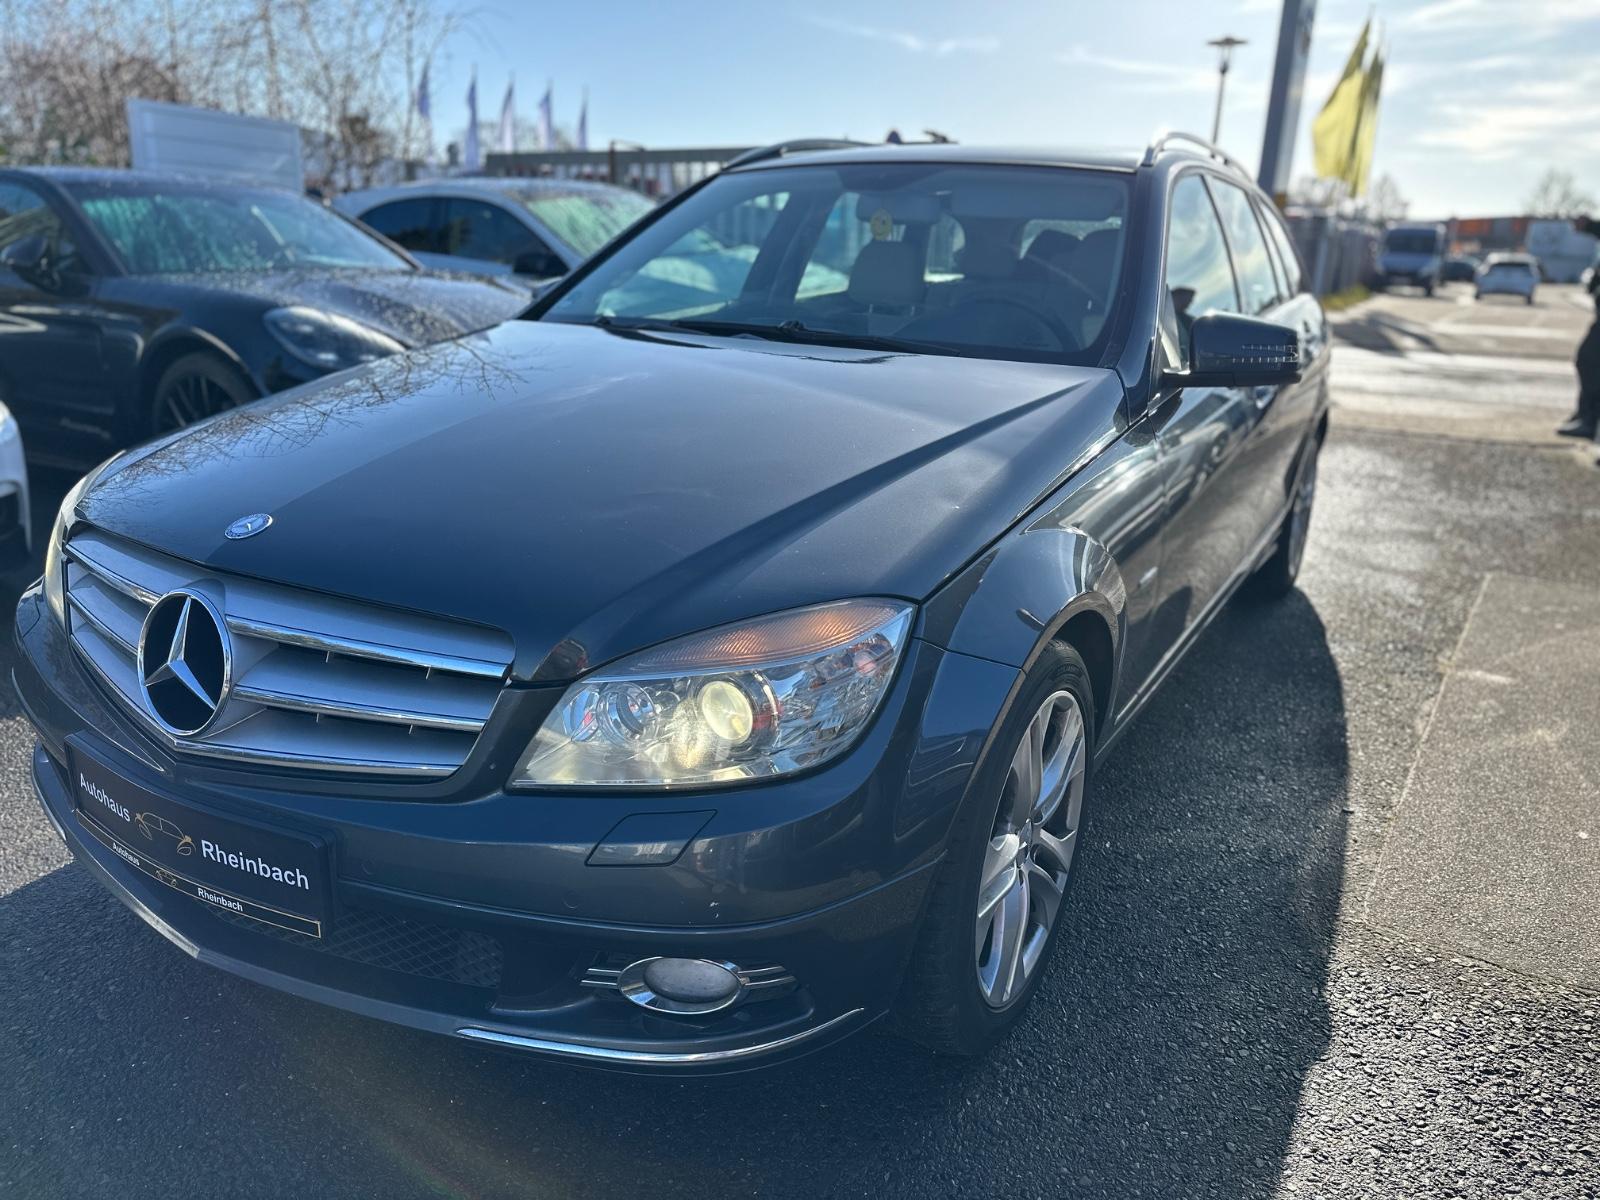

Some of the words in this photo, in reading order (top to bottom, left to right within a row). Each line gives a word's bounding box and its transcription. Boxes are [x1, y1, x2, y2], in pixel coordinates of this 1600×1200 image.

[80, 773, 131, 822] Autohaus
[201, 840, 310, 889] Rheinbach
[112, 842, 140, 866] Autohaus
[197, 887, 243, 912] Rheinbach
